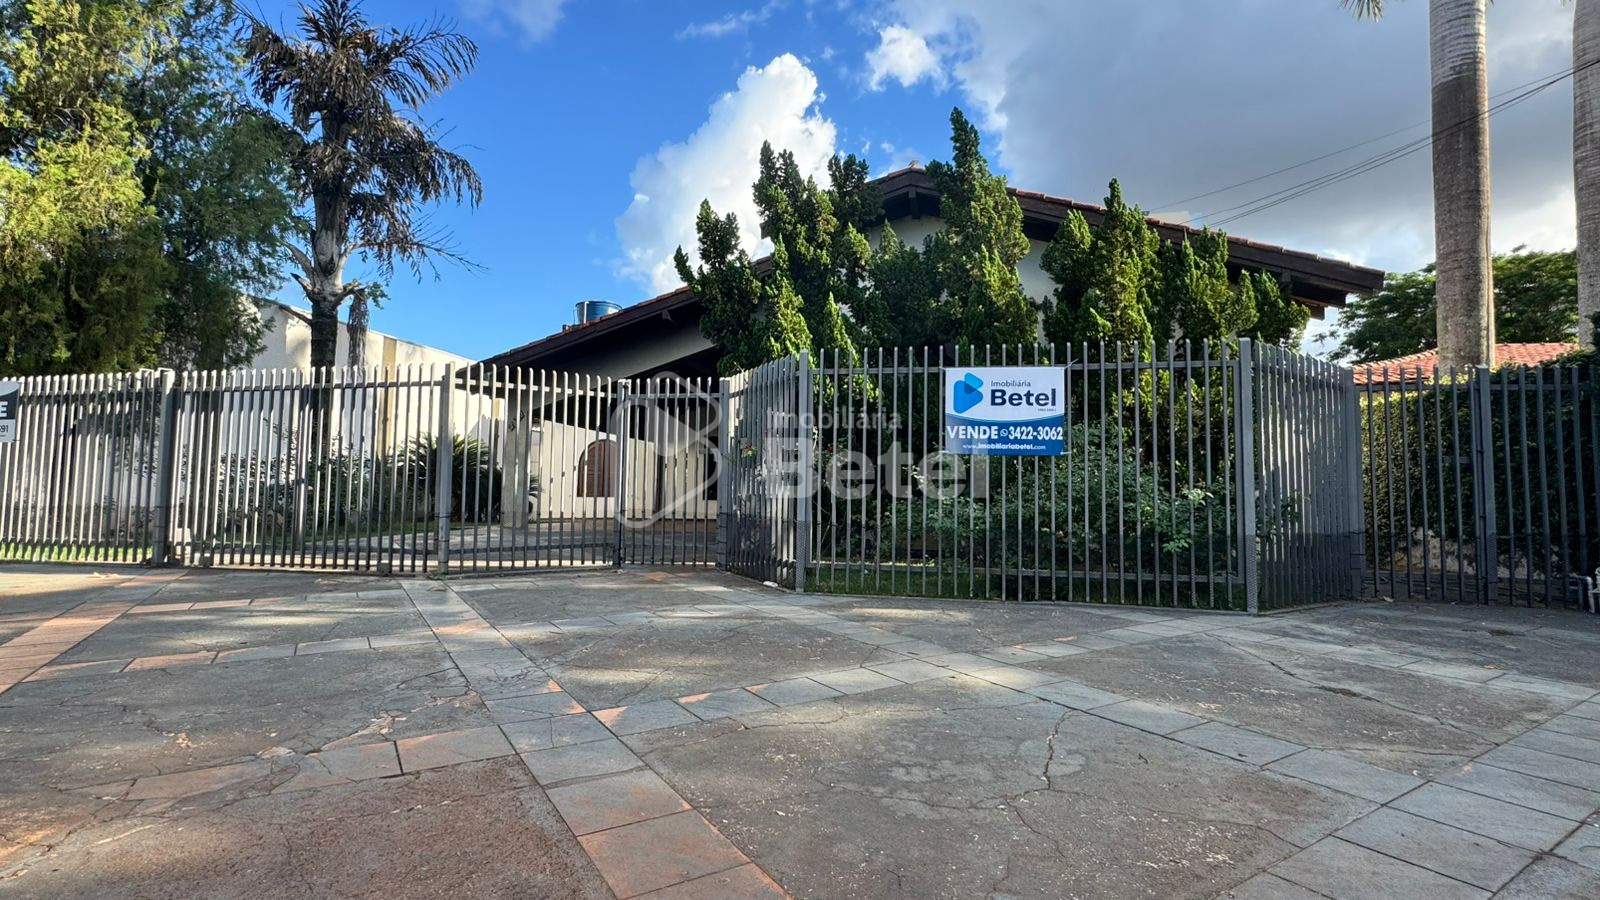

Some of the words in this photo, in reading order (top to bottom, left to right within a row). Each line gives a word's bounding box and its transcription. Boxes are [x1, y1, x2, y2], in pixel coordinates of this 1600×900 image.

[991, 380, 1031, 388] Imobiliária
[991, 388, 1056, 406] Betel
[946, 425, 998, 439] VENDE
[1009, 426, 1063, 440] 3422-3062
[963, 442, 1046, 451] www.imobiliariabetel.com
